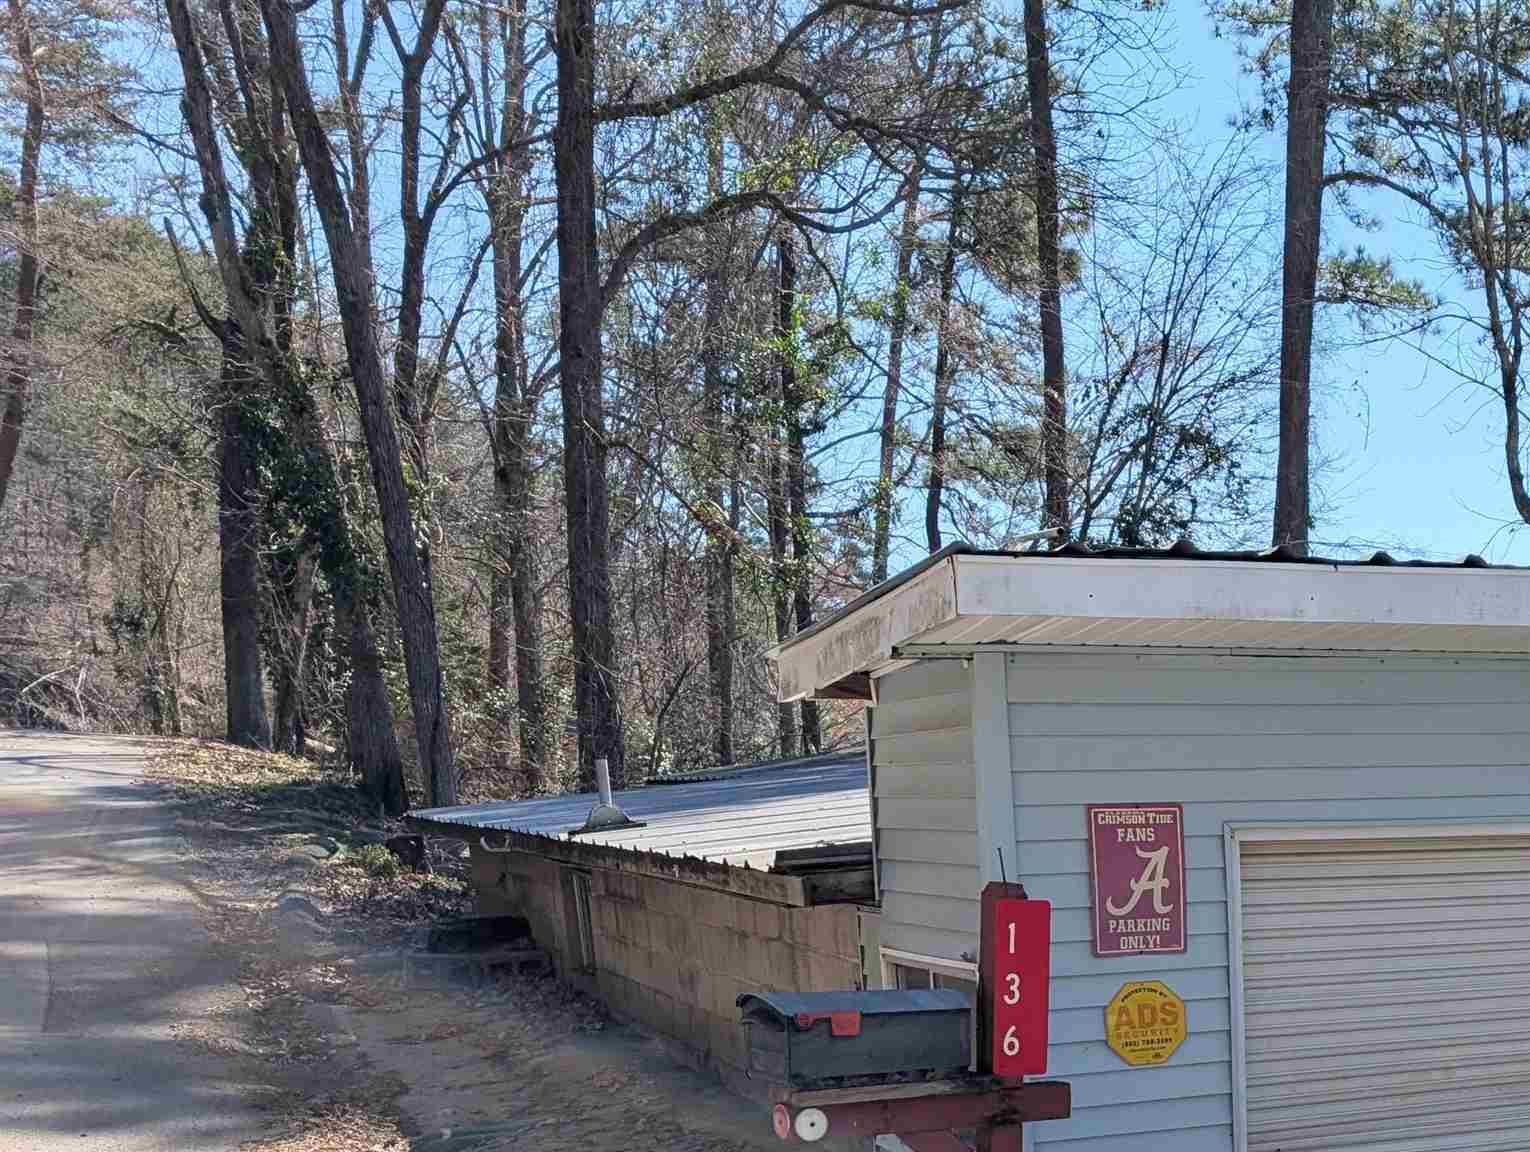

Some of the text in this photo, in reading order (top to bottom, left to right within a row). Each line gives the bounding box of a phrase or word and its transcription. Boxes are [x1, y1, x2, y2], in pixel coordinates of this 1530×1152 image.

[1117, 827, 1156, 843] FANS
[1105, 845, 1174, 917] A
[1108, 917, 1171, 934] PARKING
[1119, 936, 1161, 950] ONLY!
[1115, 1001, 1179, 1026] ADS
